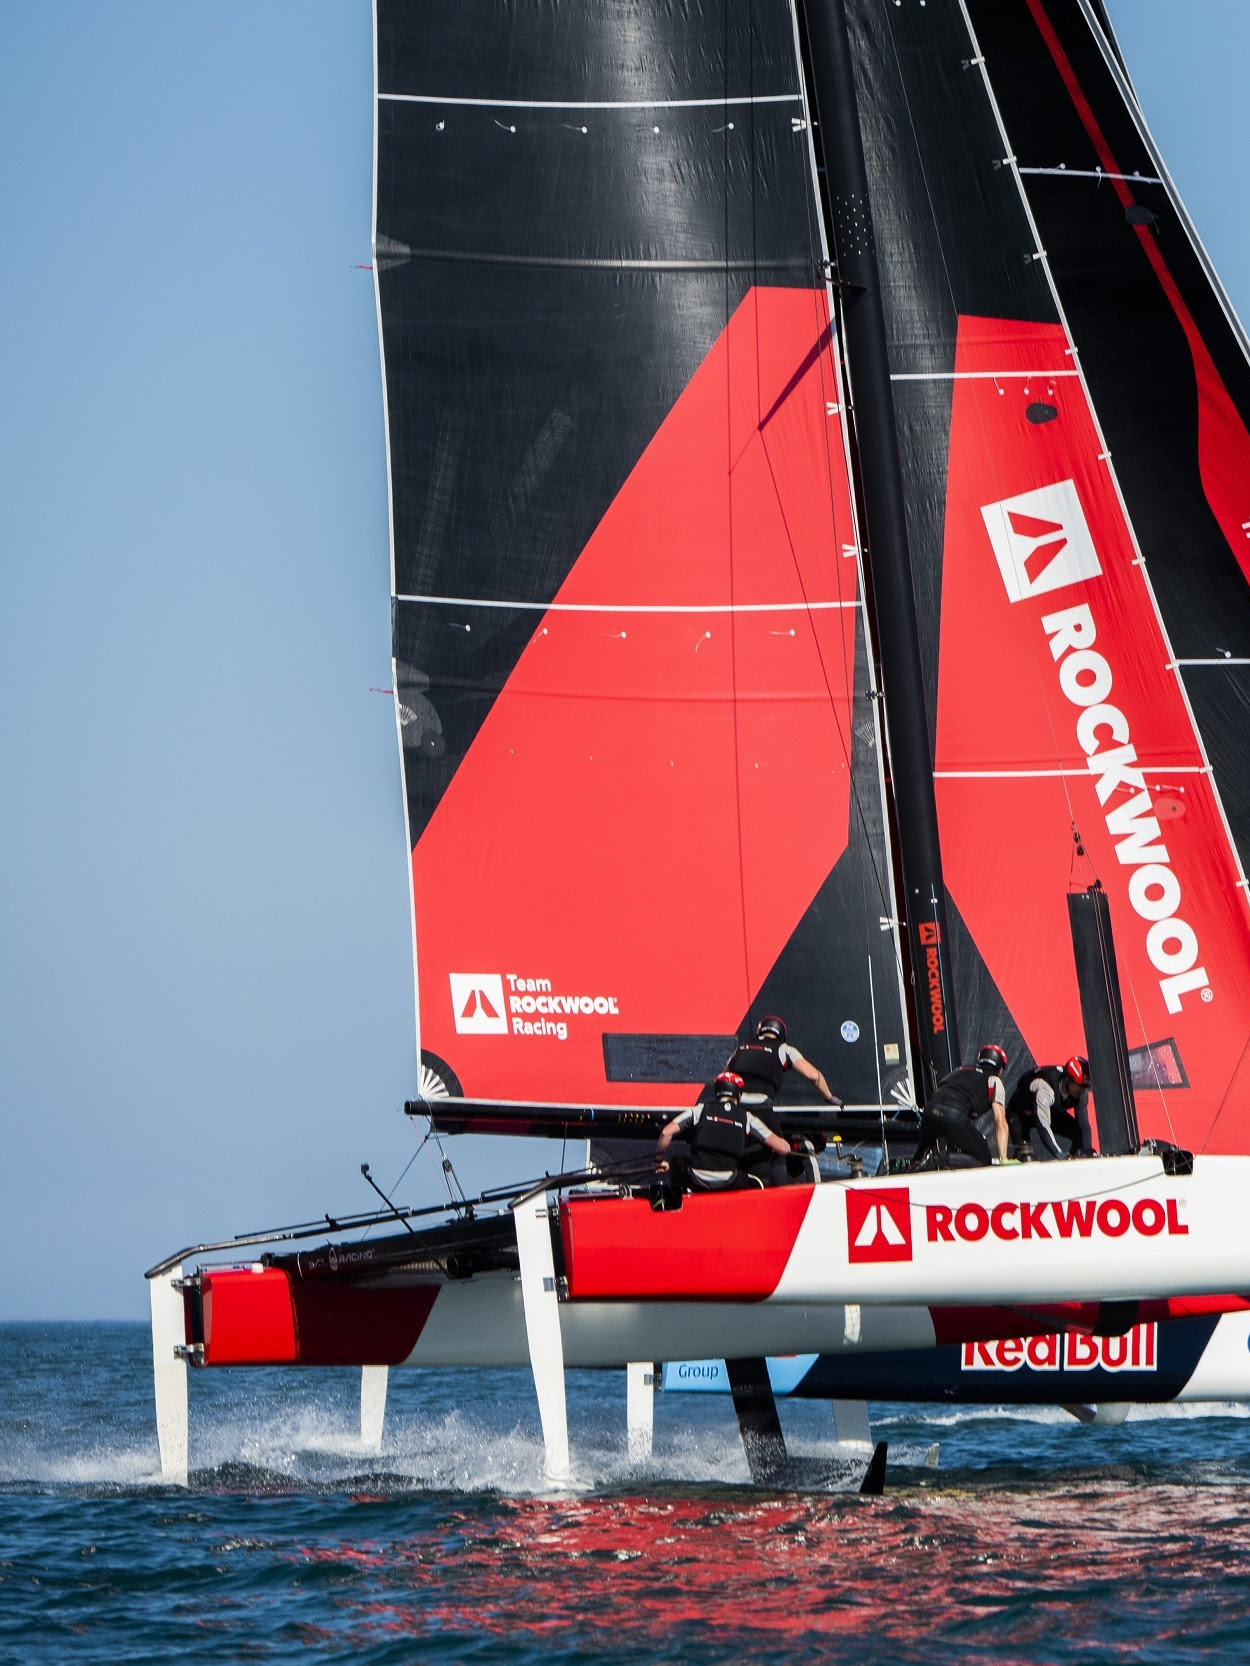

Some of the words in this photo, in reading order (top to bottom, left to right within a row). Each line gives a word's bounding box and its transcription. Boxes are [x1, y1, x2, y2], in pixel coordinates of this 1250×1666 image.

[505, 973, 552, 993] Team
[925, 946, 945, 1035] ROCKWOOL
[508, 995, 619, 1015] ROCKWOOL
[511, 1017, 568, 1041] Racing
[1064, 1322, 1157, 1372] Bull
[678, 1363, 720, 1381] Group
